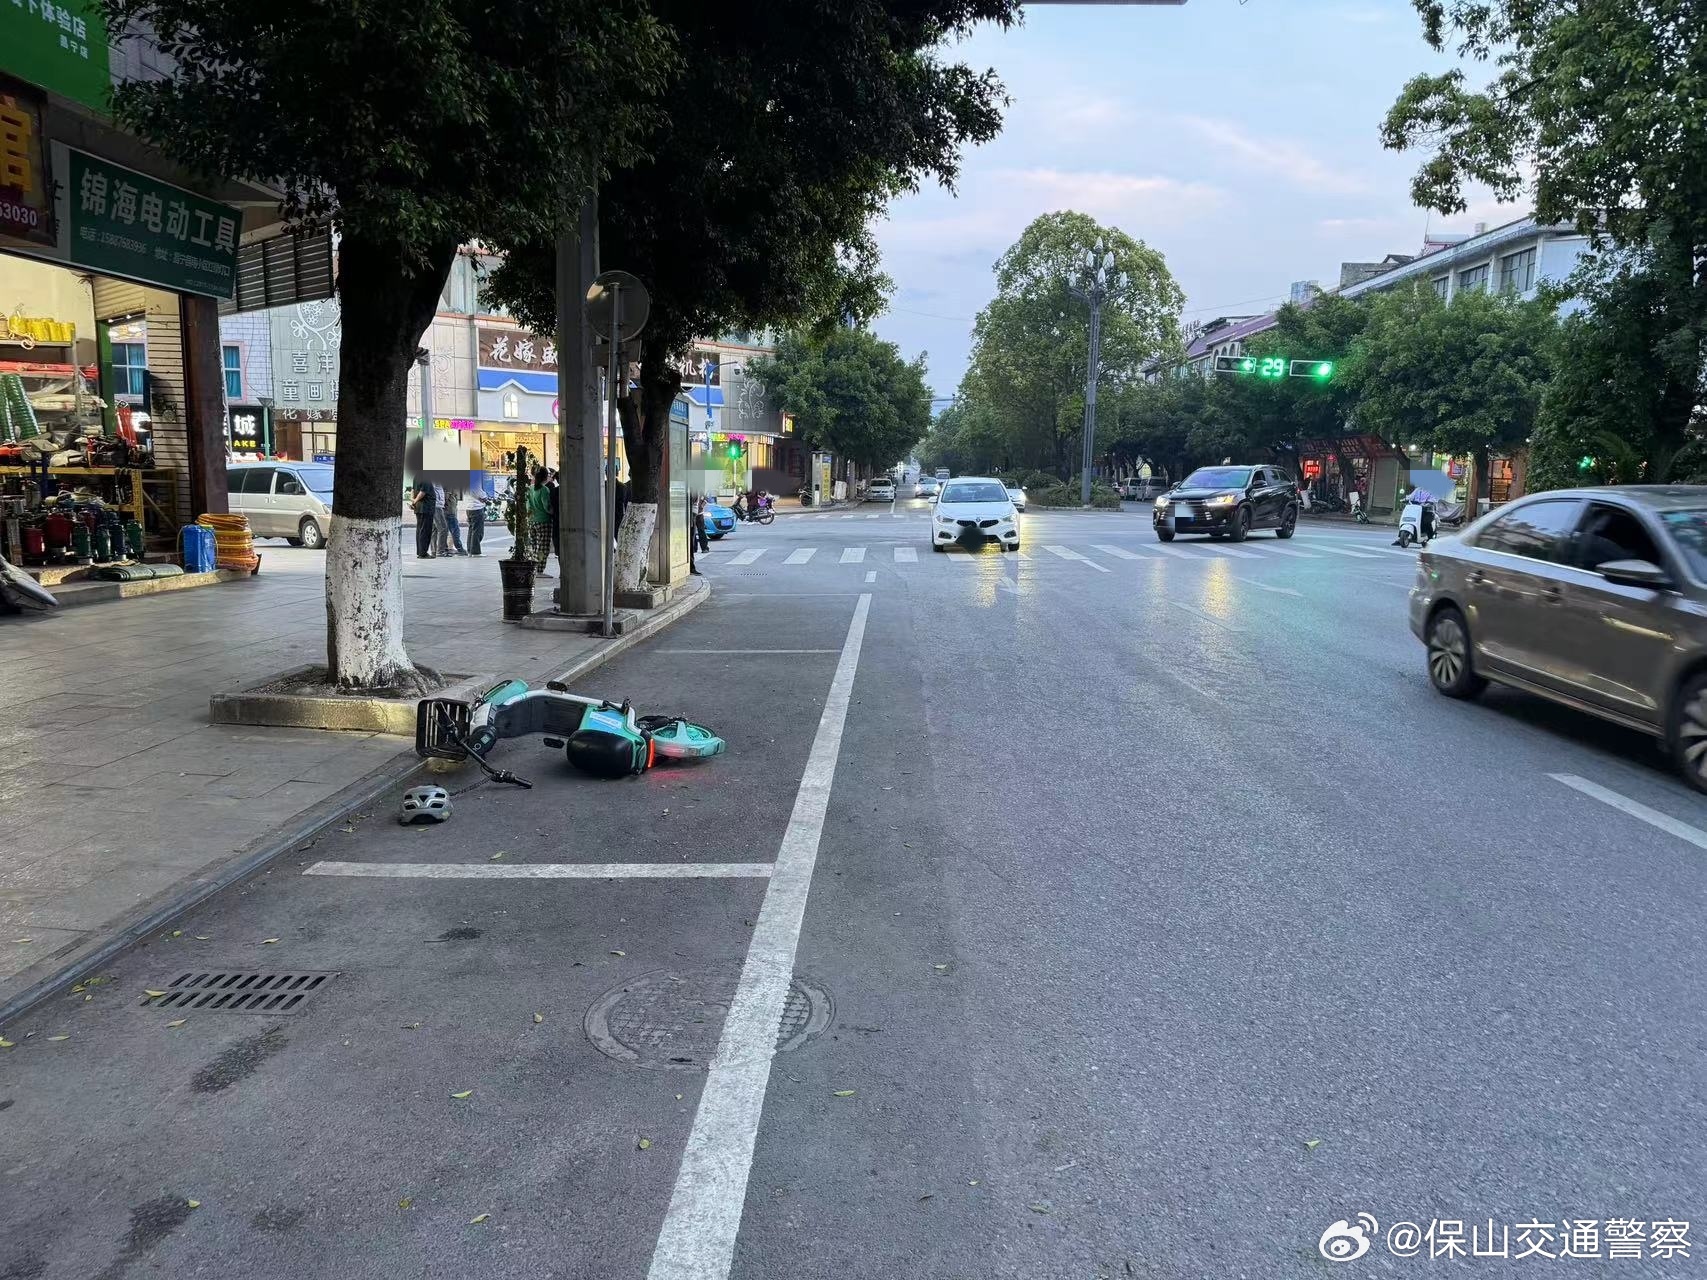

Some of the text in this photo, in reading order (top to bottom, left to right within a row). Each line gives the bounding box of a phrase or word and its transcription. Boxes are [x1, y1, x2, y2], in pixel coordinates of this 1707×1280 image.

[12, 0, 86, 40] 下体验店
[79, 167, 236, 256] 锦海电动工具
[292, 350, 334, 374] 喜洋
[1262, 357, 1285, 377] 29
